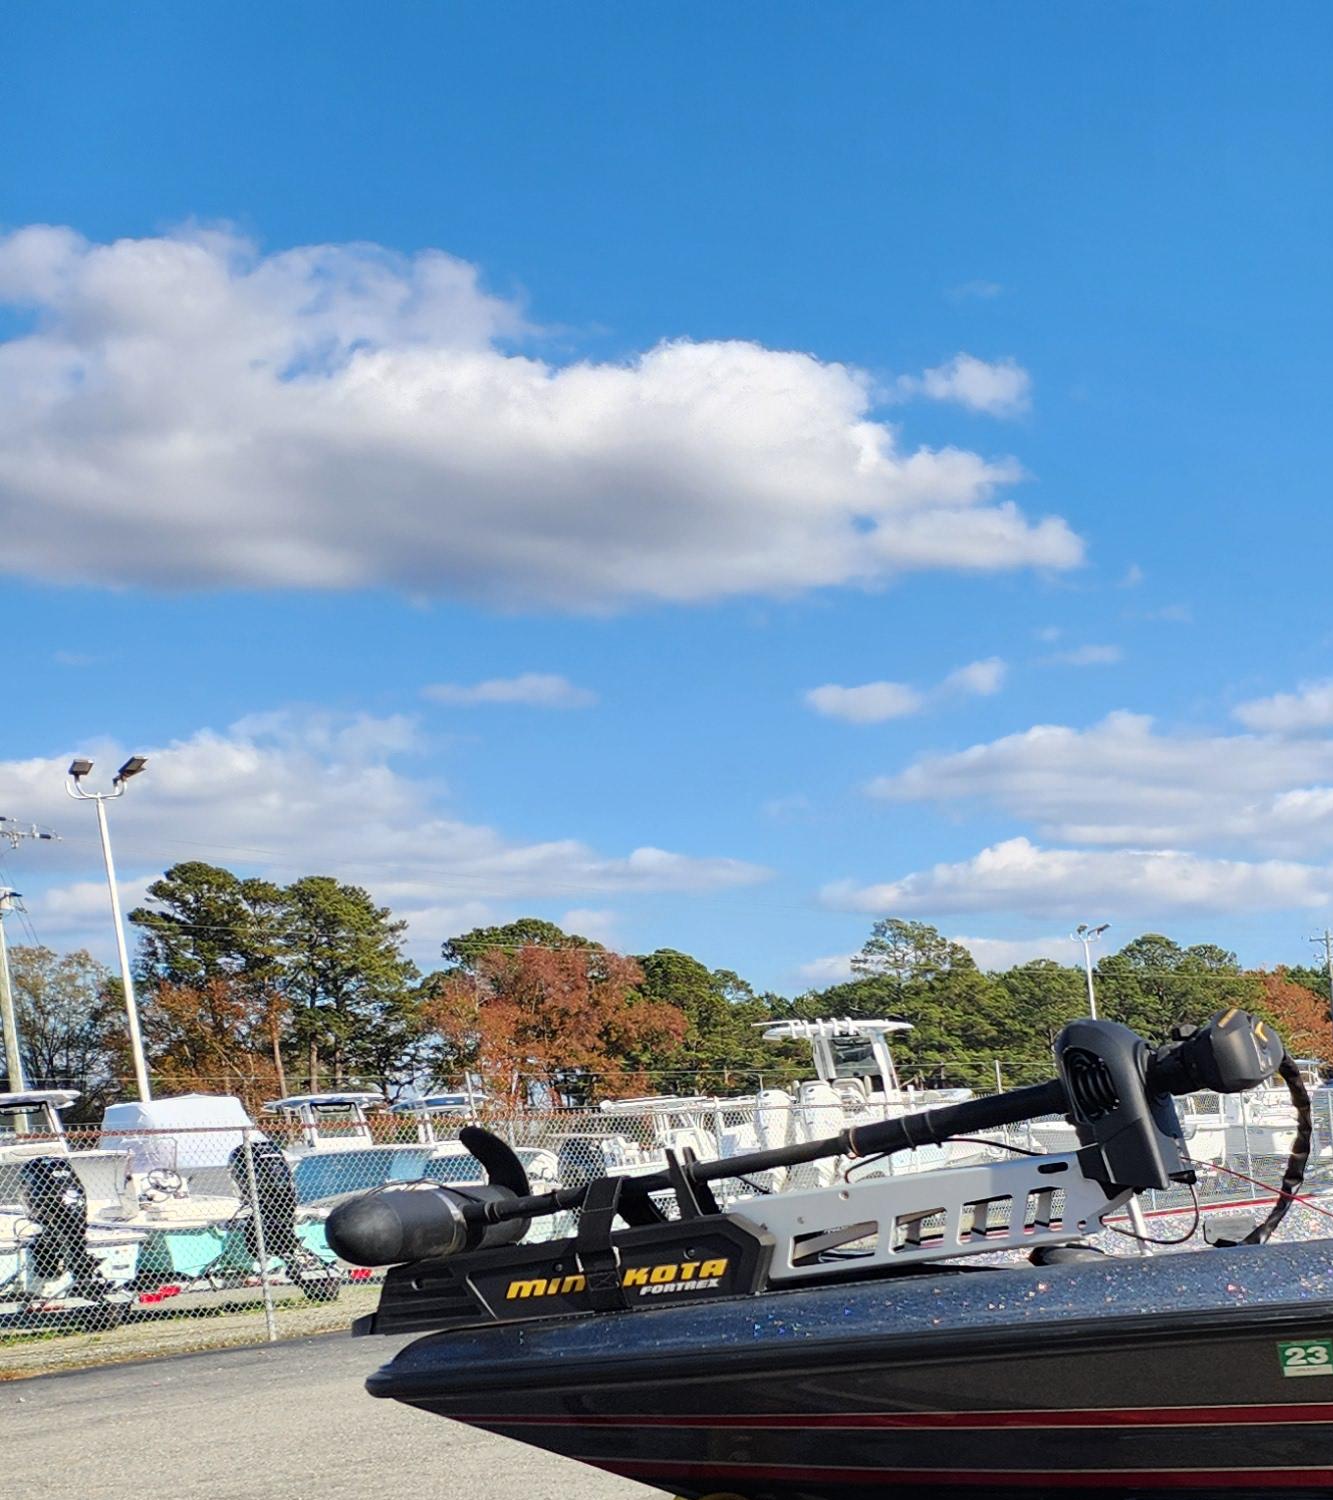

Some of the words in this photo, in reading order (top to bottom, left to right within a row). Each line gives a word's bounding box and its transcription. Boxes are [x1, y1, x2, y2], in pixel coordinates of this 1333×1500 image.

[622, 1258, 729, 1287] KOTA
[639, 1278, 720, 1296] FORTREX
[1284, 1346, 1329, 1366] 23
